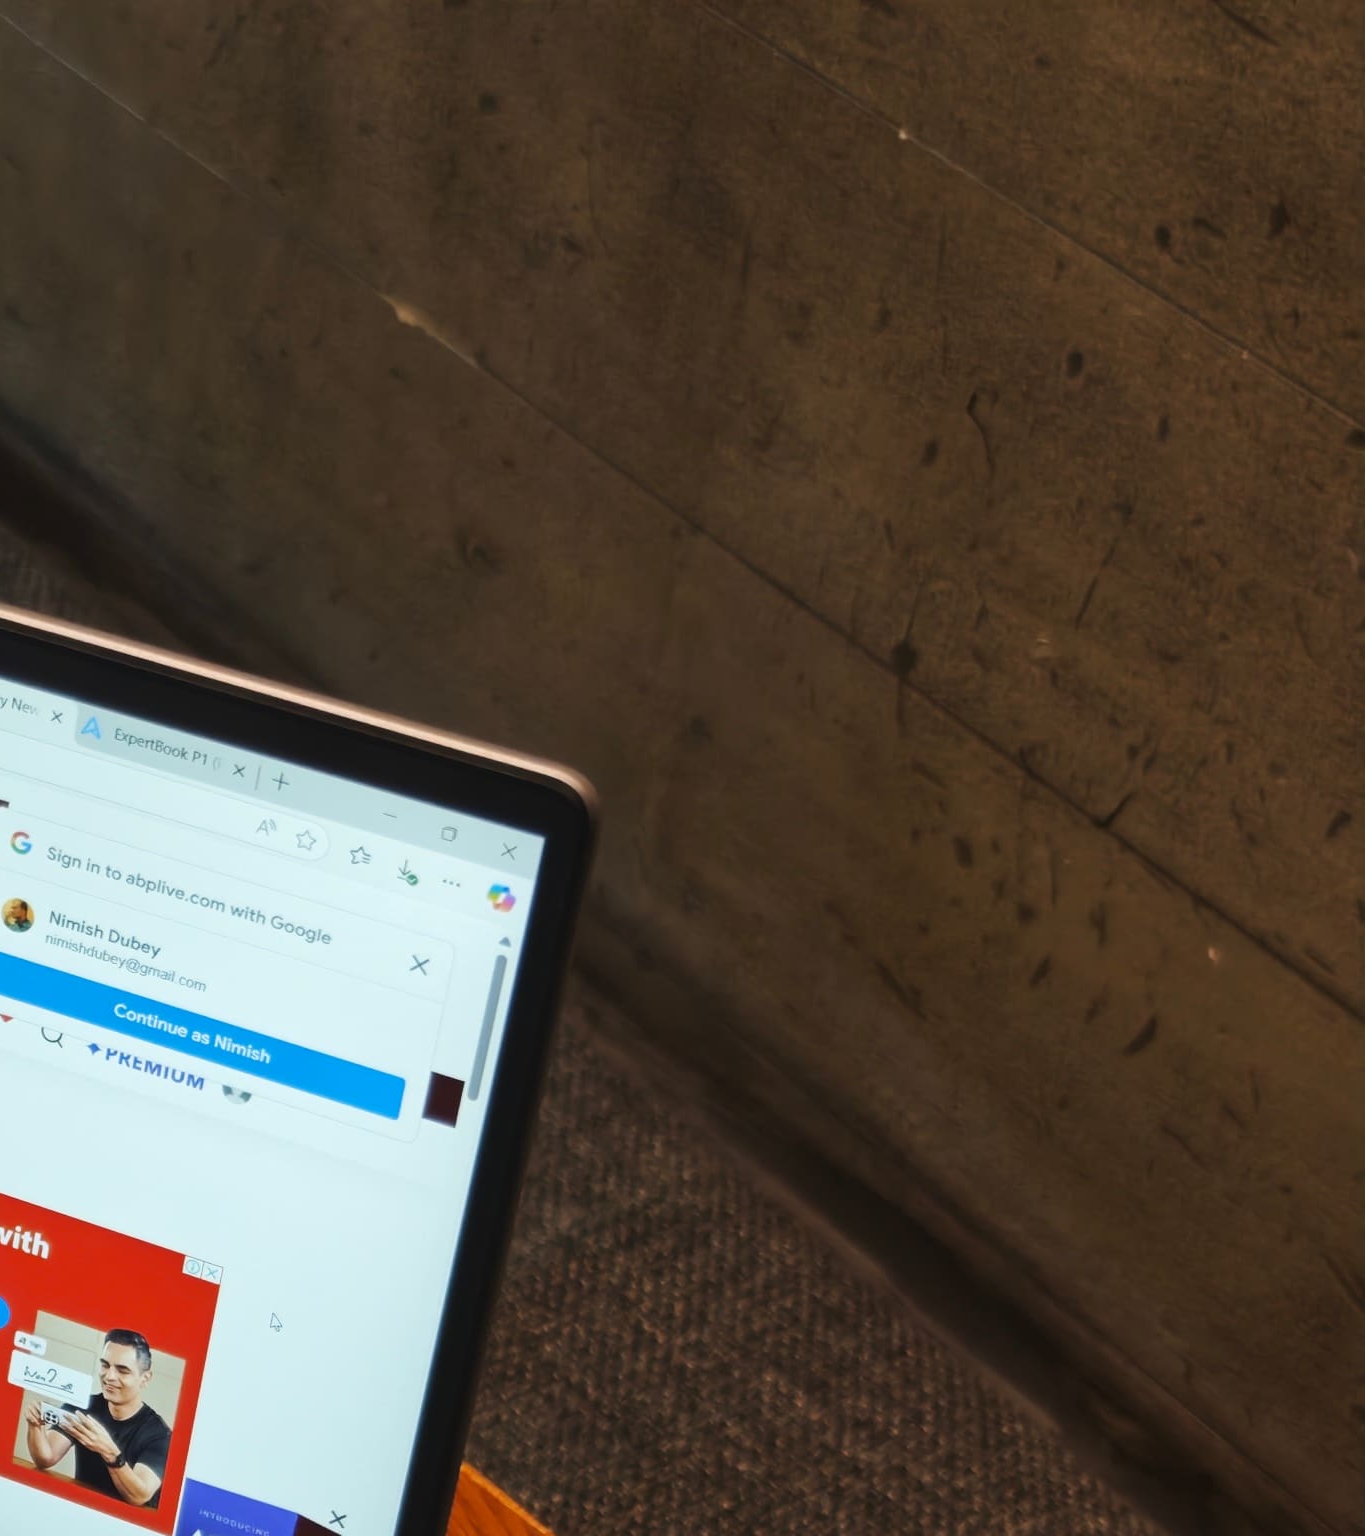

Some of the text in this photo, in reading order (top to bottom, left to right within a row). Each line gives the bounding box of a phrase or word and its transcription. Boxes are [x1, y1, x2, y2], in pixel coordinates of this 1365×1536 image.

[114, 727, 189, 760] ExpertBook
[46, 845, 332, 944] Sign abplive.com with Google
[44, 934, 206, 992] nimishdubey@gmail.com
[48, 910, 161, 959] Nimish Dubey
[113, 1003, 270, 1063] Continue Nimish
